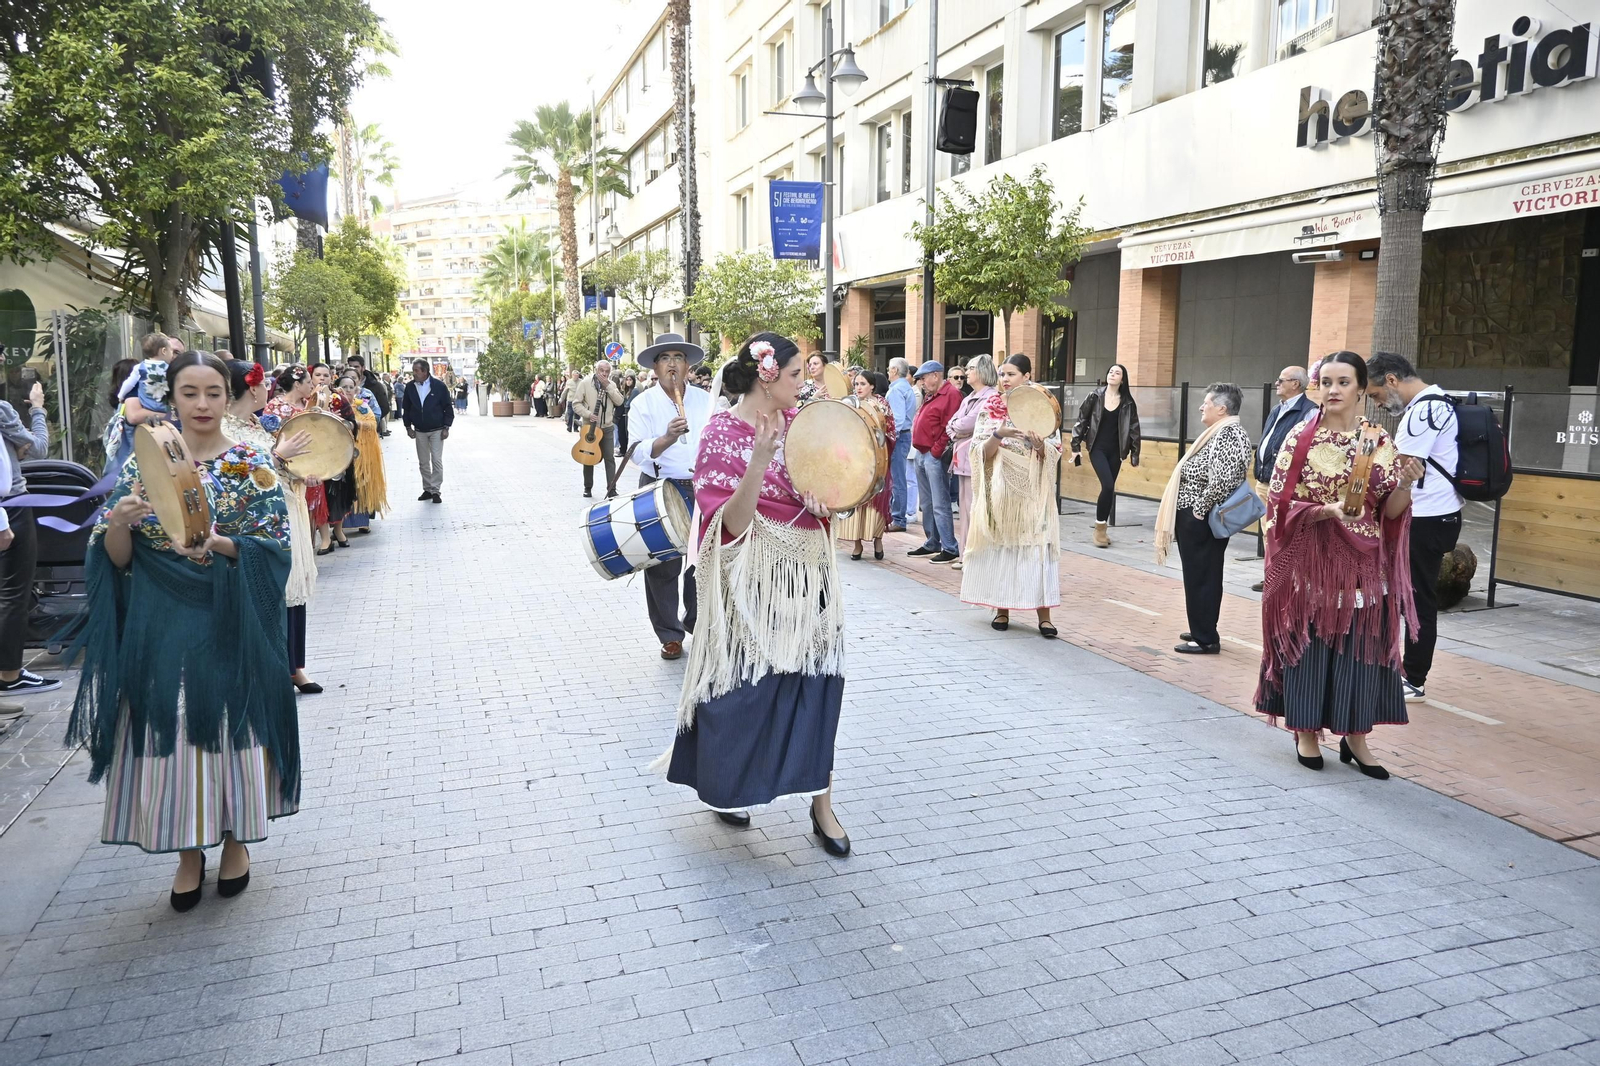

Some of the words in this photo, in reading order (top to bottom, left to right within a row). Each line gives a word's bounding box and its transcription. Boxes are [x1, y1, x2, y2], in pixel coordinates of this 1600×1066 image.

[1296, 15, 1594, 148] heetia
[1521, 174, 1600, 196] CERVEZA
[774, 191, 782, 207] 51
[1512, 188, 1600, 214] VICTORI
[1150, 250, 1196, 265] VICTORIA
[2, 347, 31, 357] KEY
[1556, 431, 1599, 445] BLIS
